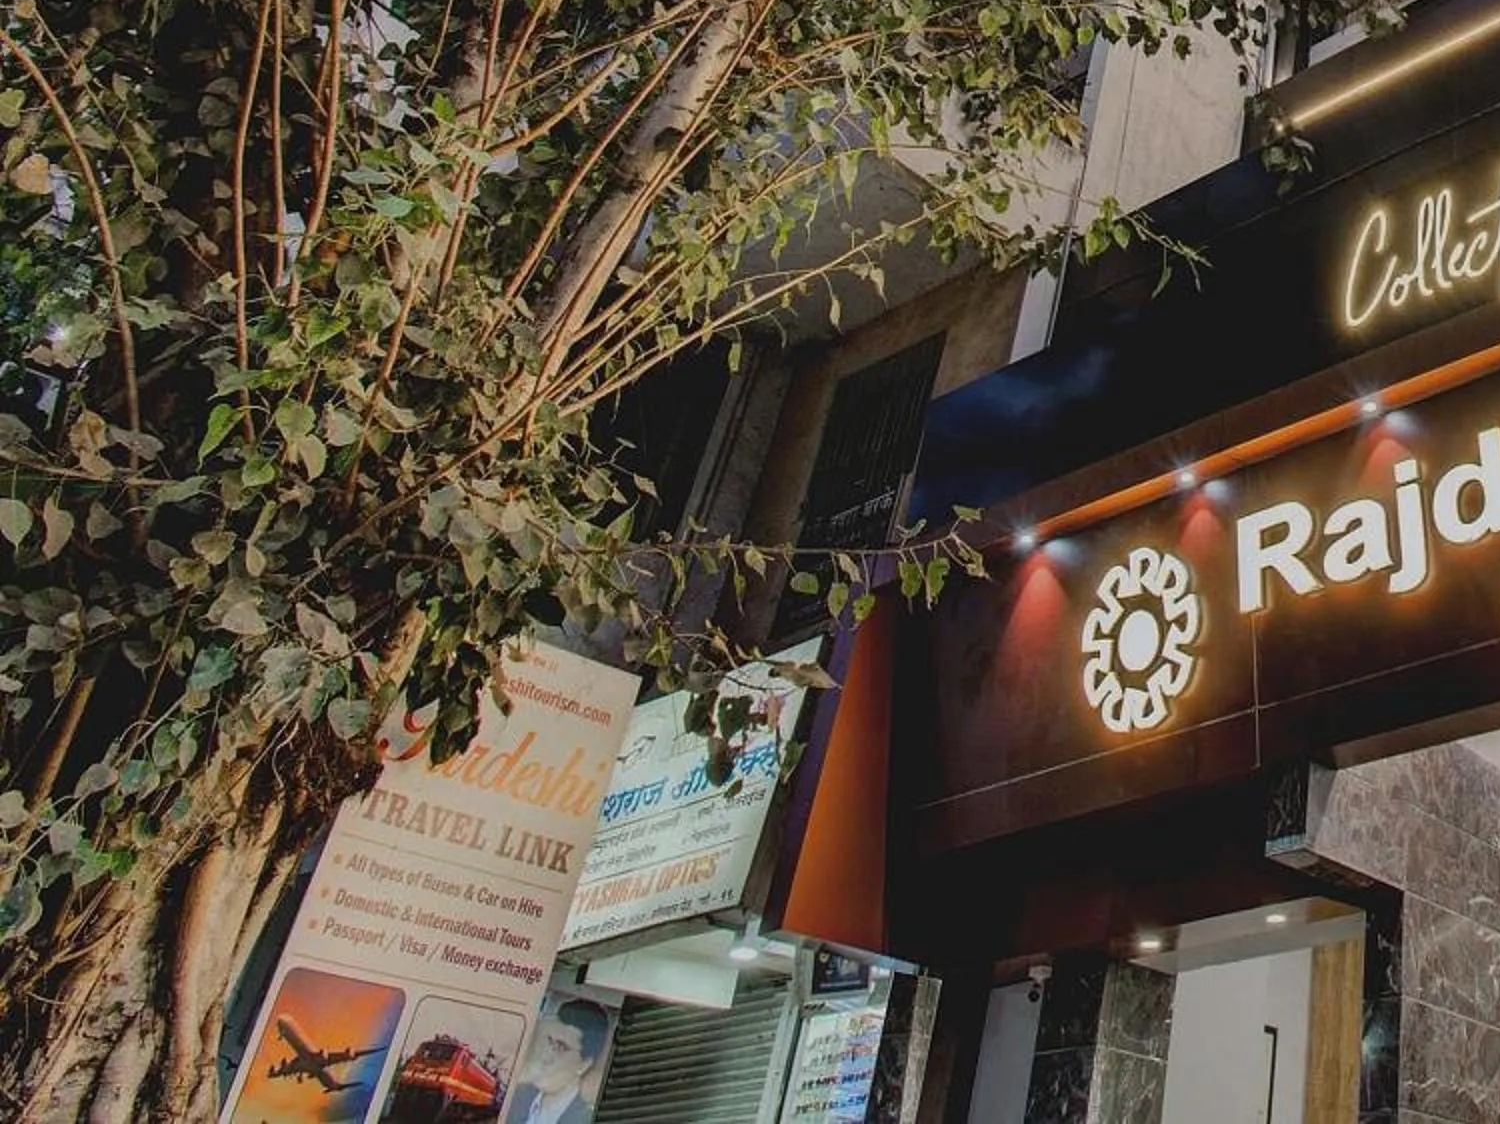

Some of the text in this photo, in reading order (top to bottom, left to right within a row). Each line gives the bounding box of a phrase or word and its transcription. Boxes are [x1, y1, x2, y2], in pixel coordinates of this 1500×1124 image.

[504, 677, 612, 726] shitourism.com
[362, 789, 487, 849] TRAVEL
[495, 826, 574, 874] LINK
[346, 852, 544, 918] All types of Buses & Car on Hire
[322, 916, 385, 948] Passport
[400, 934, 429, 957] Visa
[441, 944, 484, 973] Money
[485, 955, 543, 984] exchange
[334, 888, 533, 952] Domestic & International Tours
